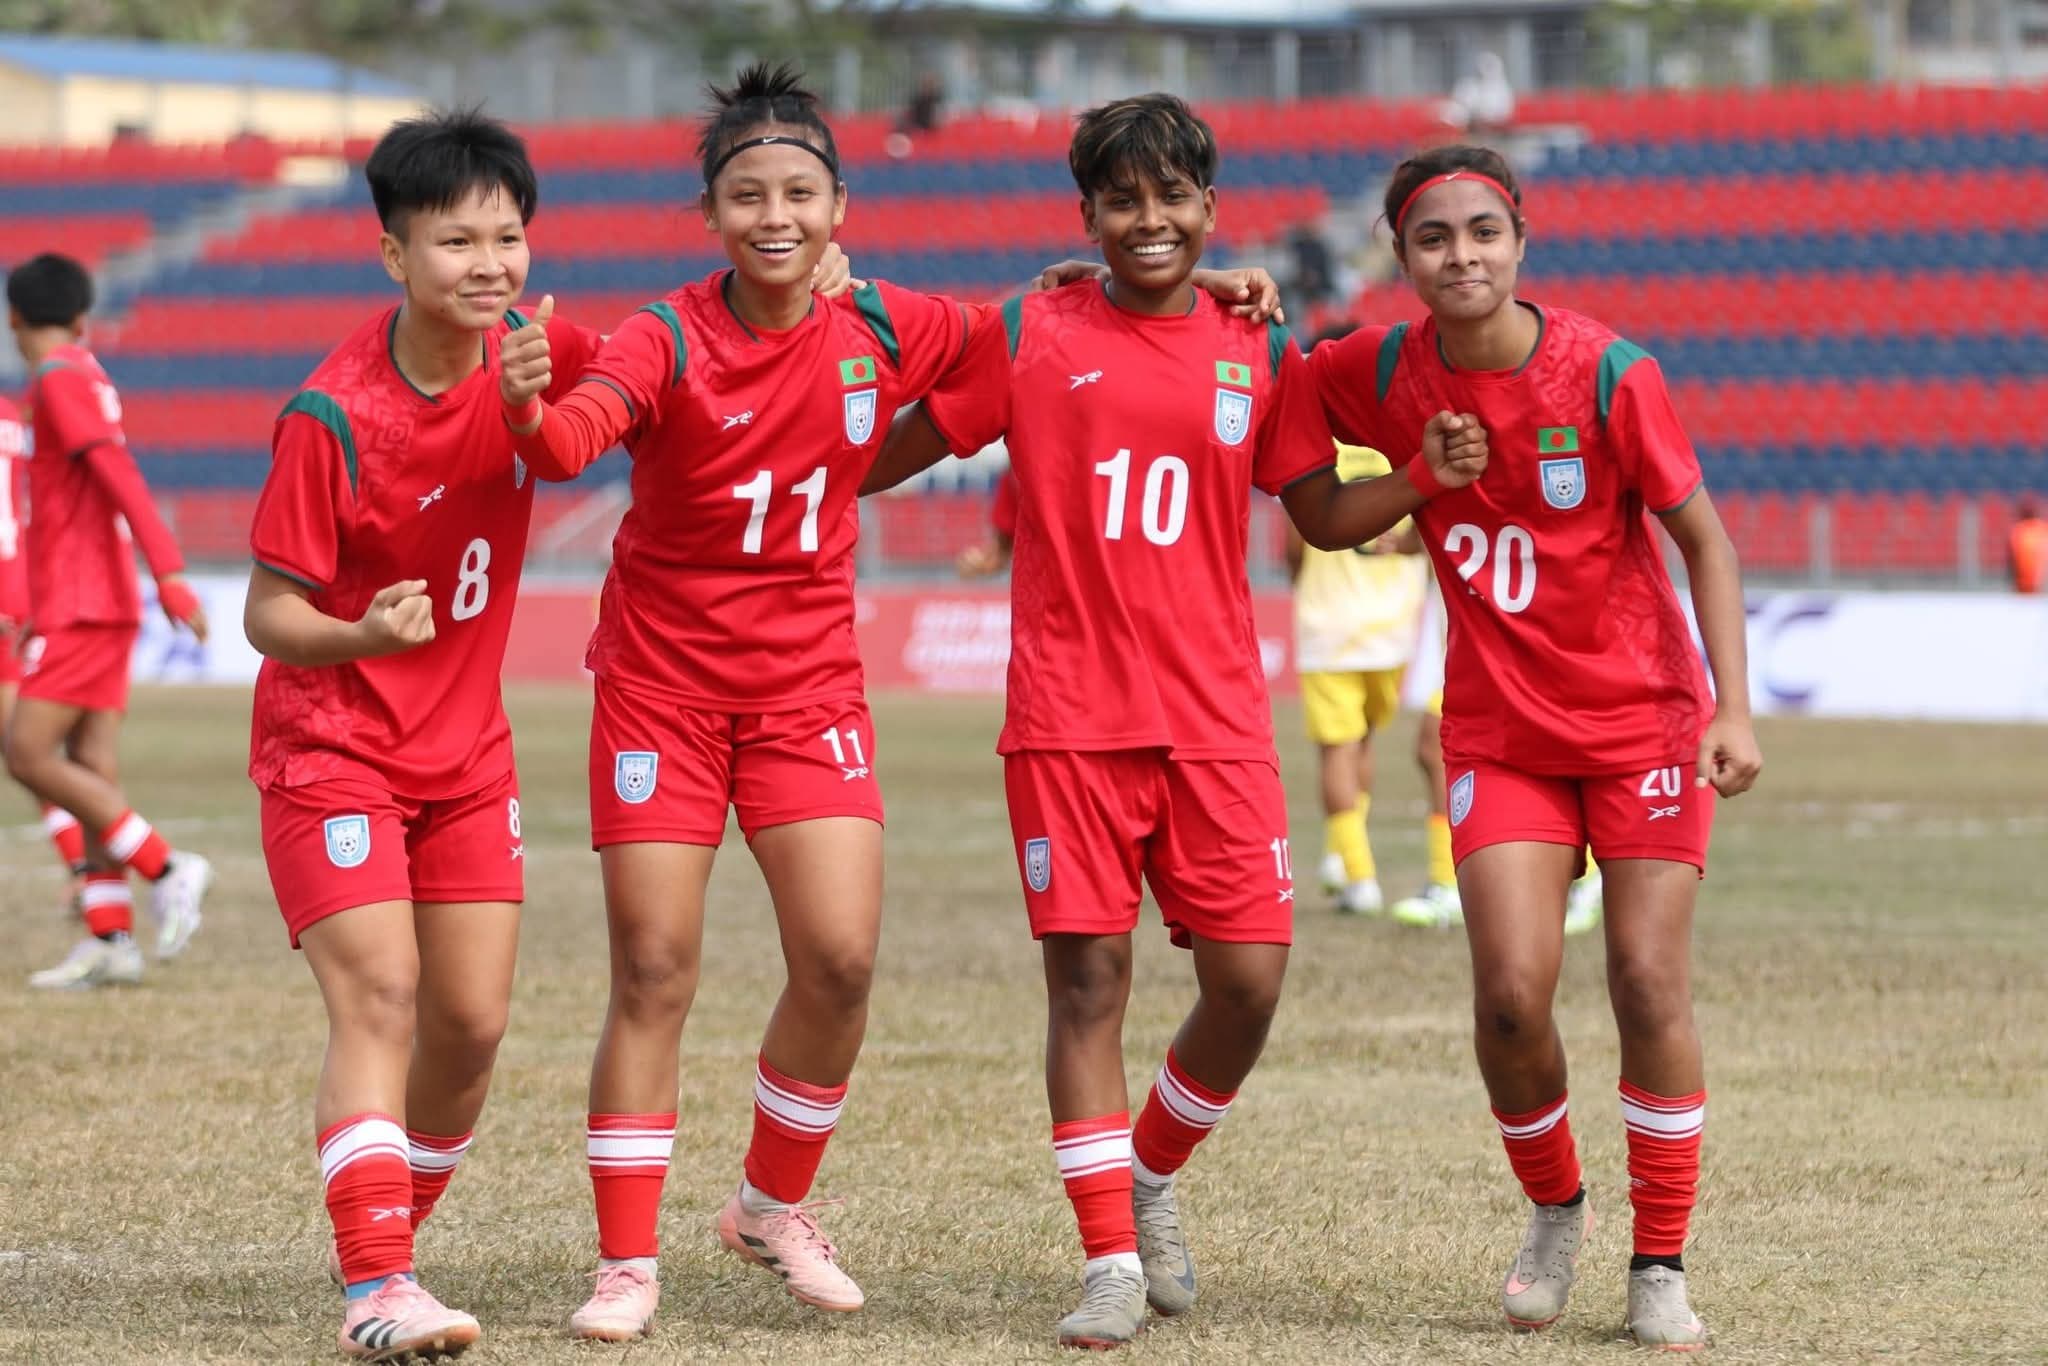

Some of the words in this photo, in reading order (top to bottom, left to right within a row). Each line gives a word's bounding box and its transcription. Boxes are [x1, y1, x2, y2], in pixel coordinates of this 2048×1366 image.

[732, 466, 828, 554] 11
[1094, 448, 1190, 546] 10
[451, 537, 491, 622] 8
[1443, 523, 1537, 614] 20
[821, 727, 866, 765] 11
[508, 797, 521, 839] 8
